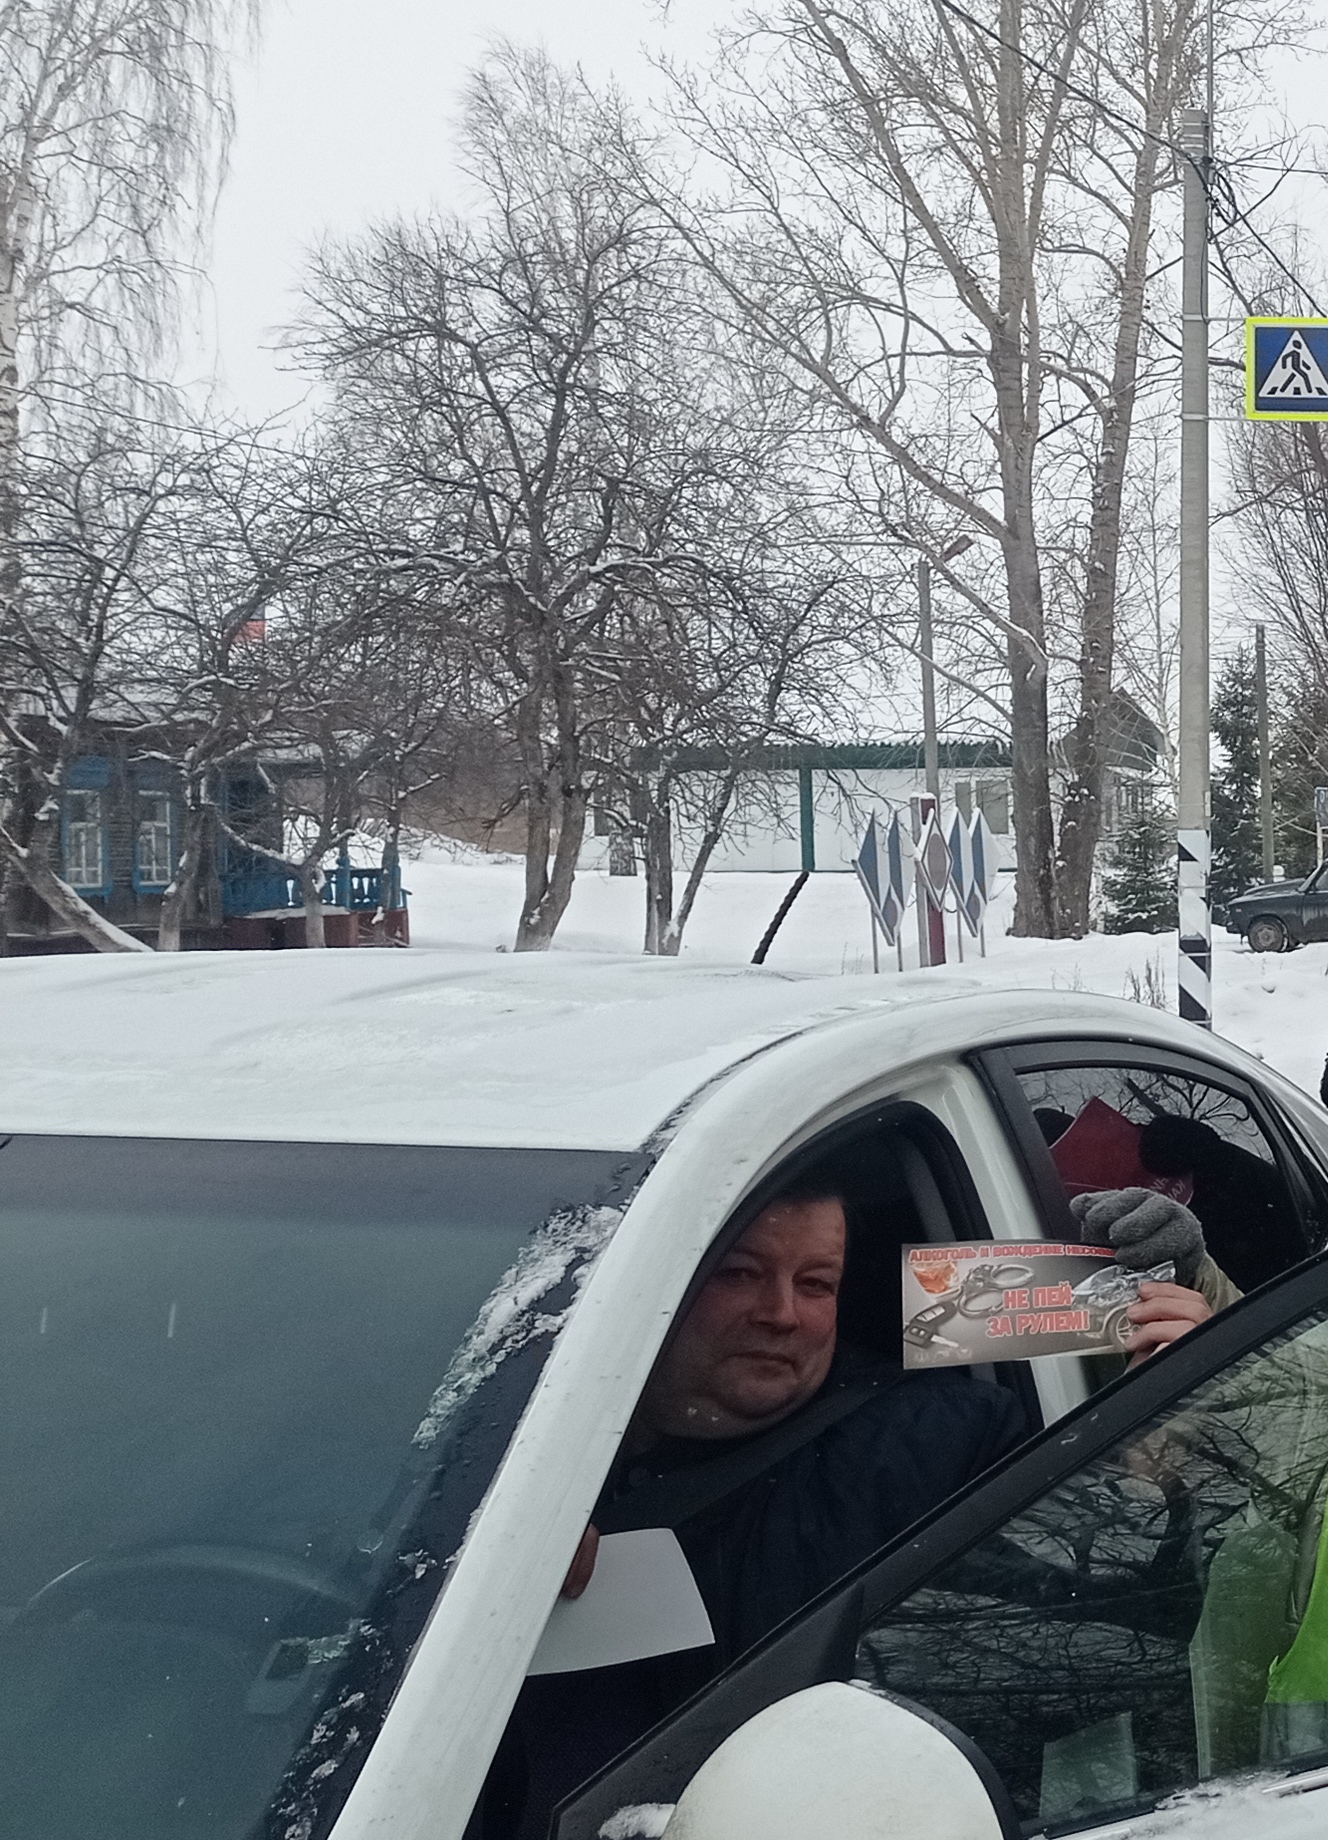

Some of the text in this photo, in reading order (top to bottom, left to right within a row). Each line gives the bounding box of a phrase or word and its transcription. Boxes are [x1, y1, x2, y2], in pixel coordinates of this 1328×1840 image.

[909, 1247, 977, 1262] АЛКОГОЛЬ
[979, 1246, 990, 1258] И
[992, 1244, 1064, 1259] ВОЖДЕНИЕ
[1002, 1281, 1072, 1310] НЕ ПЕЙ
[985, 1310, 1090, 1338] ЗА РУЛЕМ!
